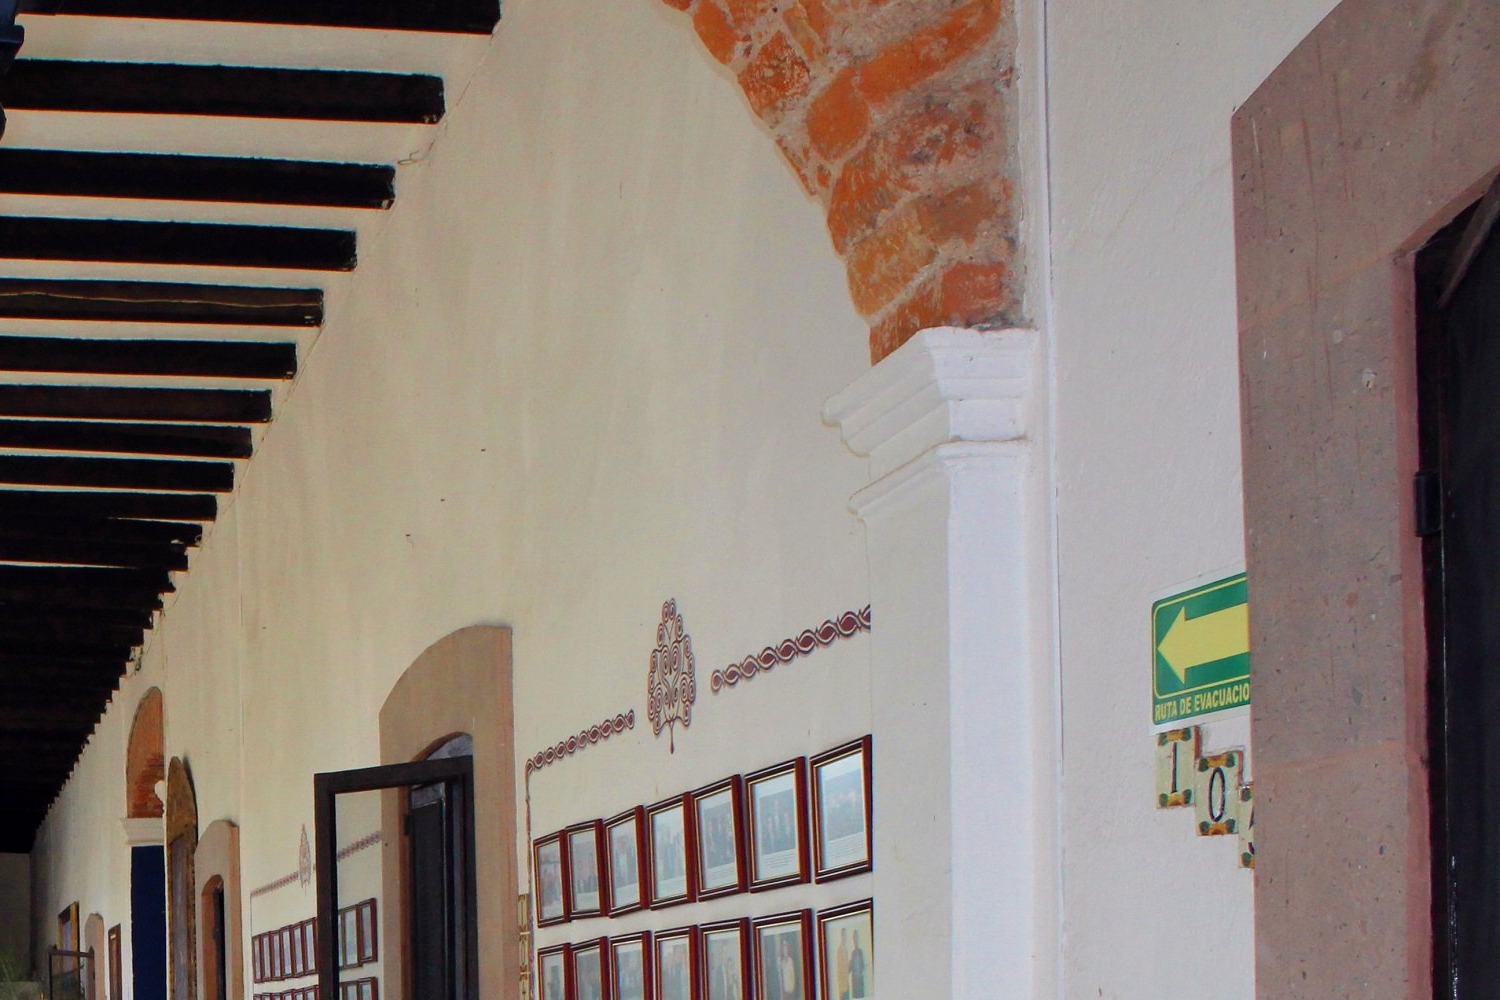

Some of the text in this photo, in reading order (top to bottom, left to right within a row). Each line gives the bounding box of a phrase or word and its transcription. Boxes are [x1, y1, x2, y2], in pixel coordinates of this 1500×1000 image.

[1155, 682, 1250, 721] RUTA DE EVACUACIO
